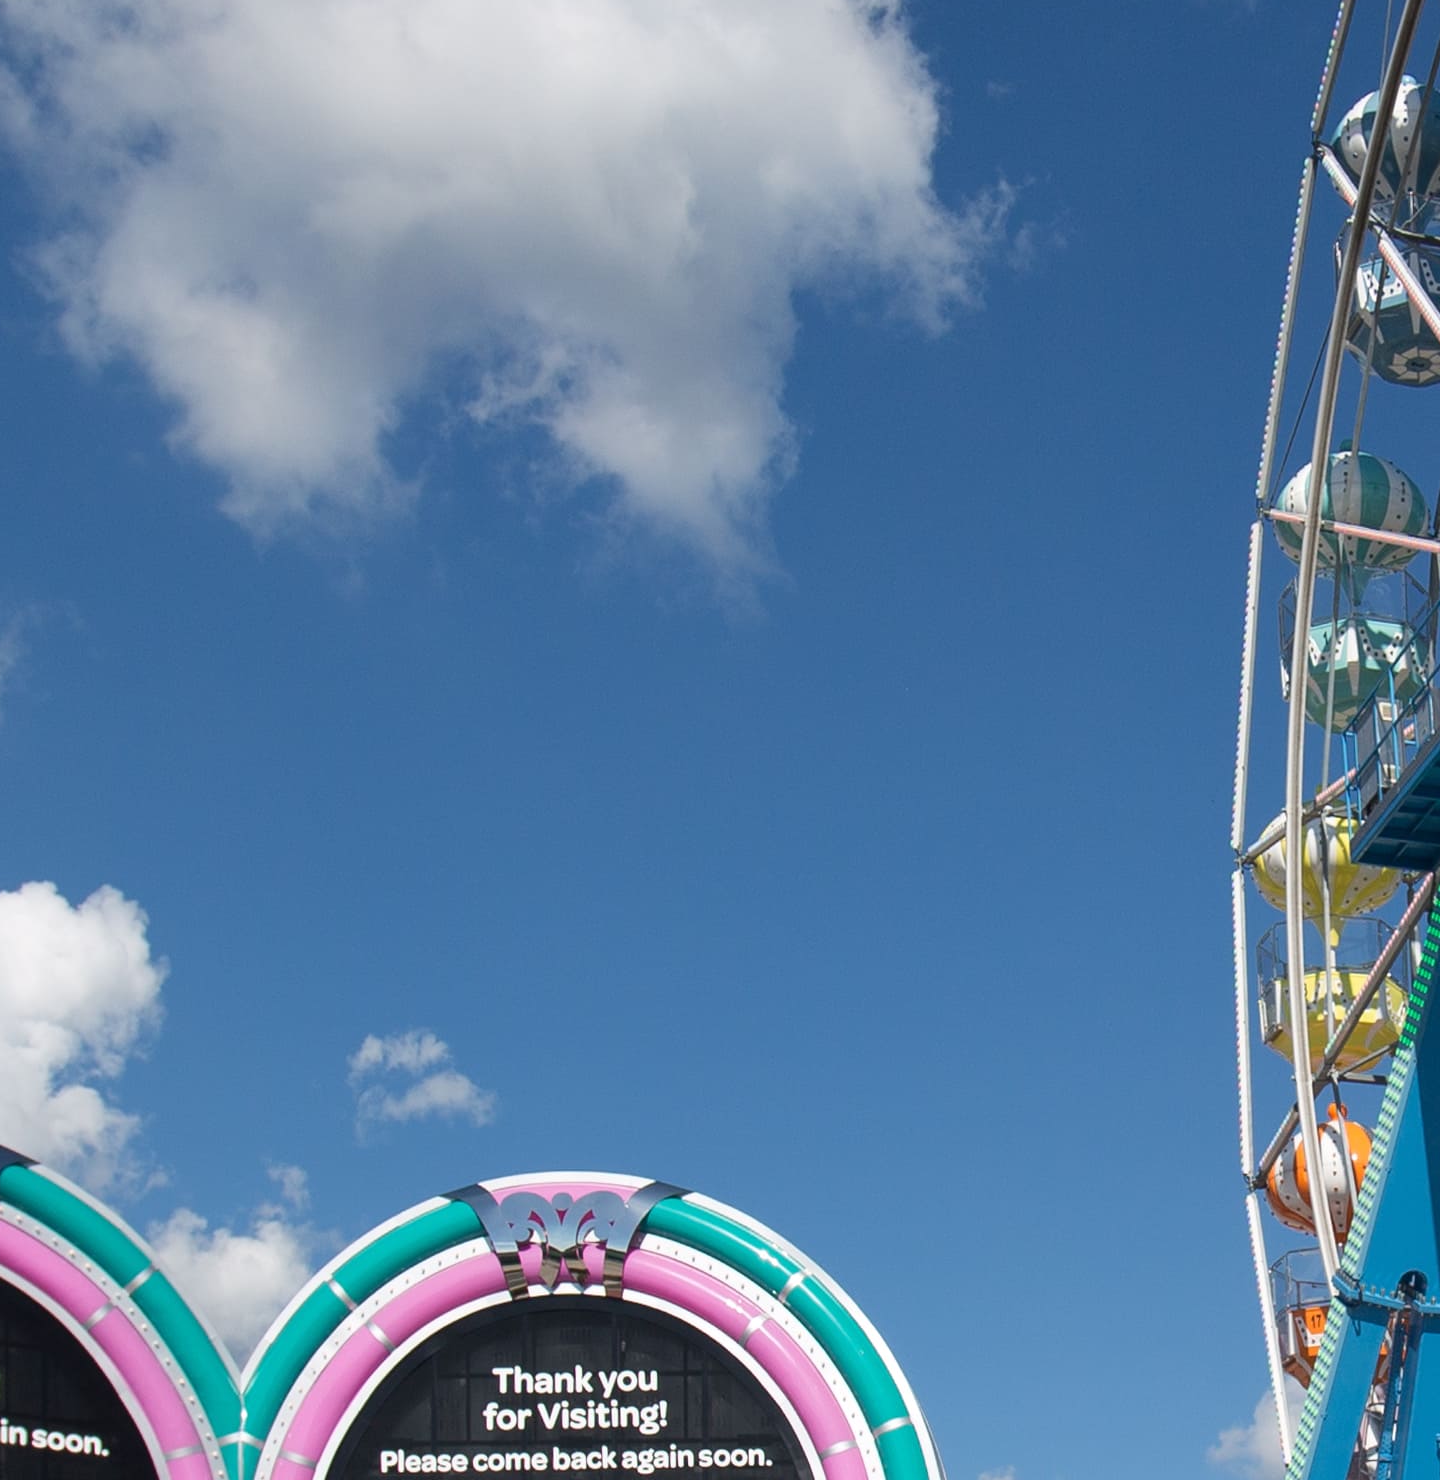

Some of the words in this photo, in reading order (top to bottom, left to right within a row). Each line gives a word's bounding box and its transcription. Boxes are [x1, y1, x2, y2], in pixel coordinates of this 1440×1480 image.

[1311, 1314, 1322, 1328] 17
[492, 1365, 594, 1394] Thank
[598, 1370, 658, 1399] you
[482, 1402, 532, 1431] for
[538, 1399, 668, 1435] Visiting!
[31, 1428, 110, 1457] soon.
[380, 1449, 469, 1473] Please
[472, 1452, 548, 1472] come
[552, 1445, 618, 1471] back
[621, 1444, 695, 1475] again
[698, 1447, 773, 1468] soon.
